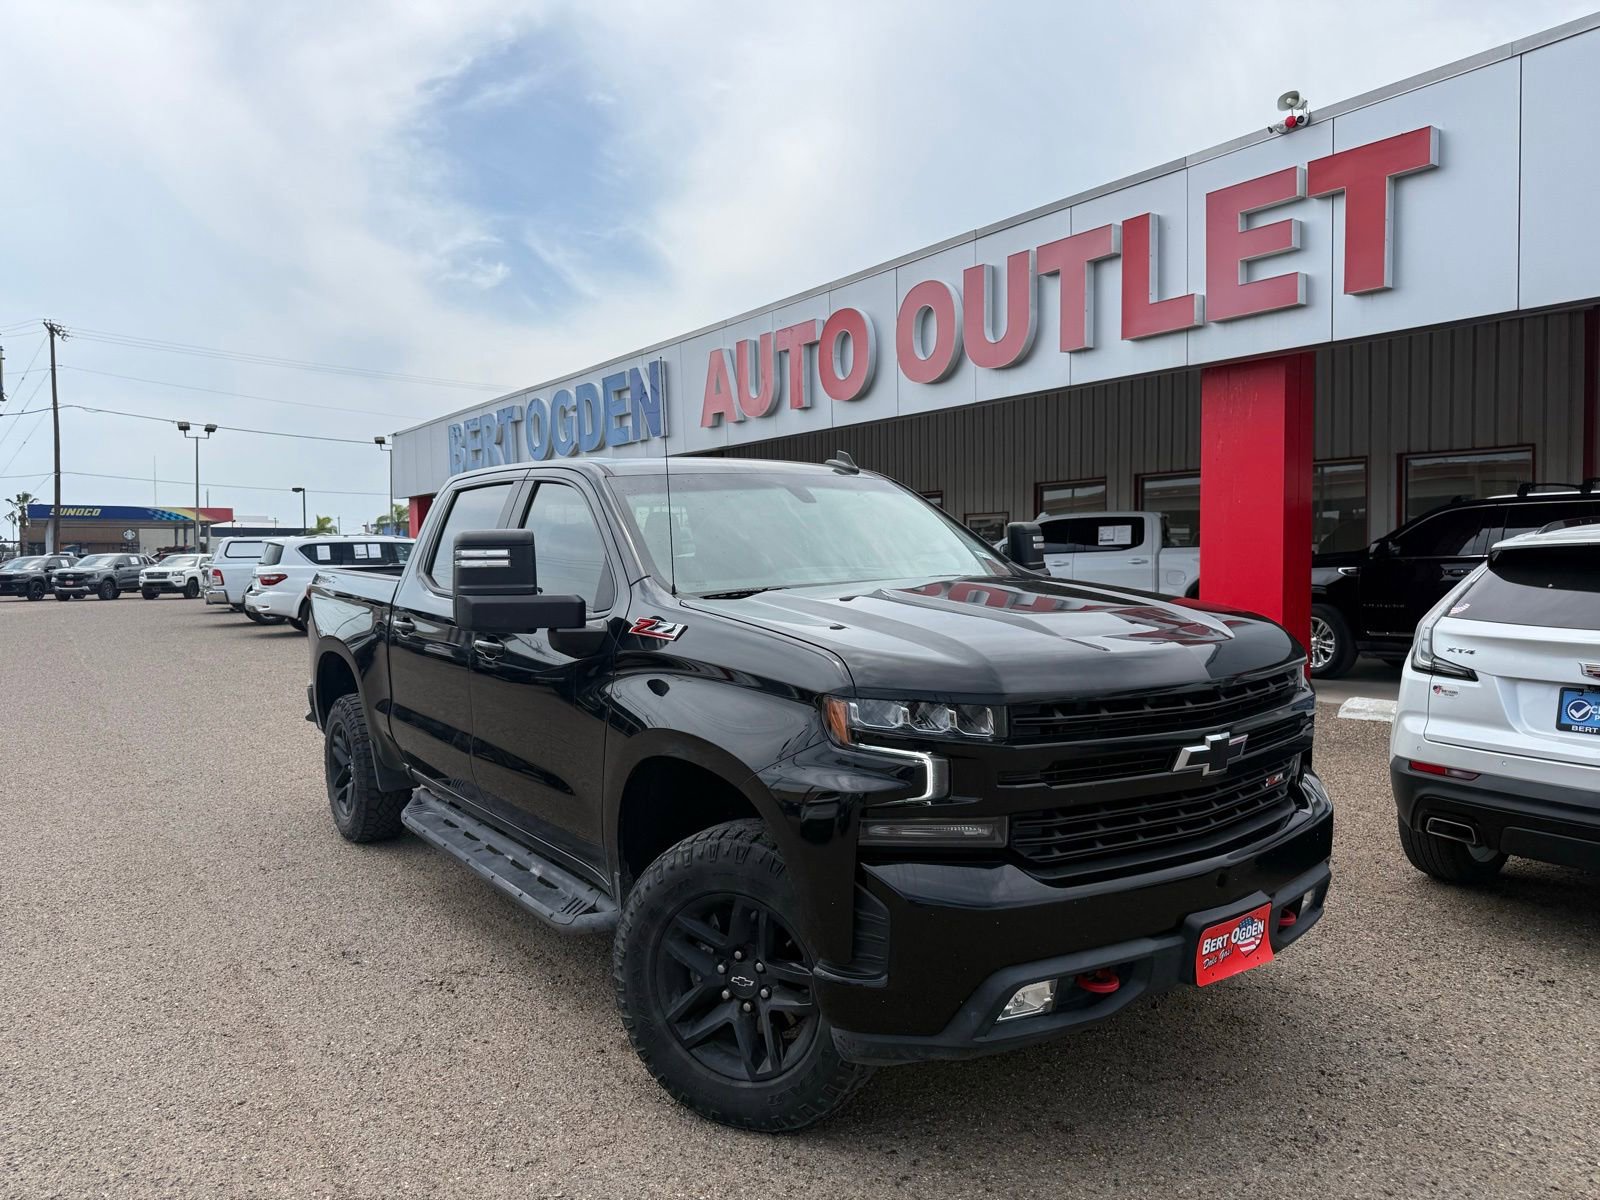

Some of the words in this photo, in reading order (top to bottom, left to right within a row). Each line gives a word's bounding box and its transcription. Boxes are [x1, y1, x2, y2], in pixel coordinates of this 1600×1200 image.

[700, 306, 877, 428] AUTO
[896, 125, 1440, 384] OUTLET
[448, 405, 523, 475] BERT
[525, 360, 669, 461] OGDEN
[628, 616, 688, 641] Z71
[1446, 647, 1476, 655] XT4
[1571, 724, 1599, 734] BERT
[1202, 933, 1230, 956] BERT
[1231, 919, 1265, 944] OGDEN
